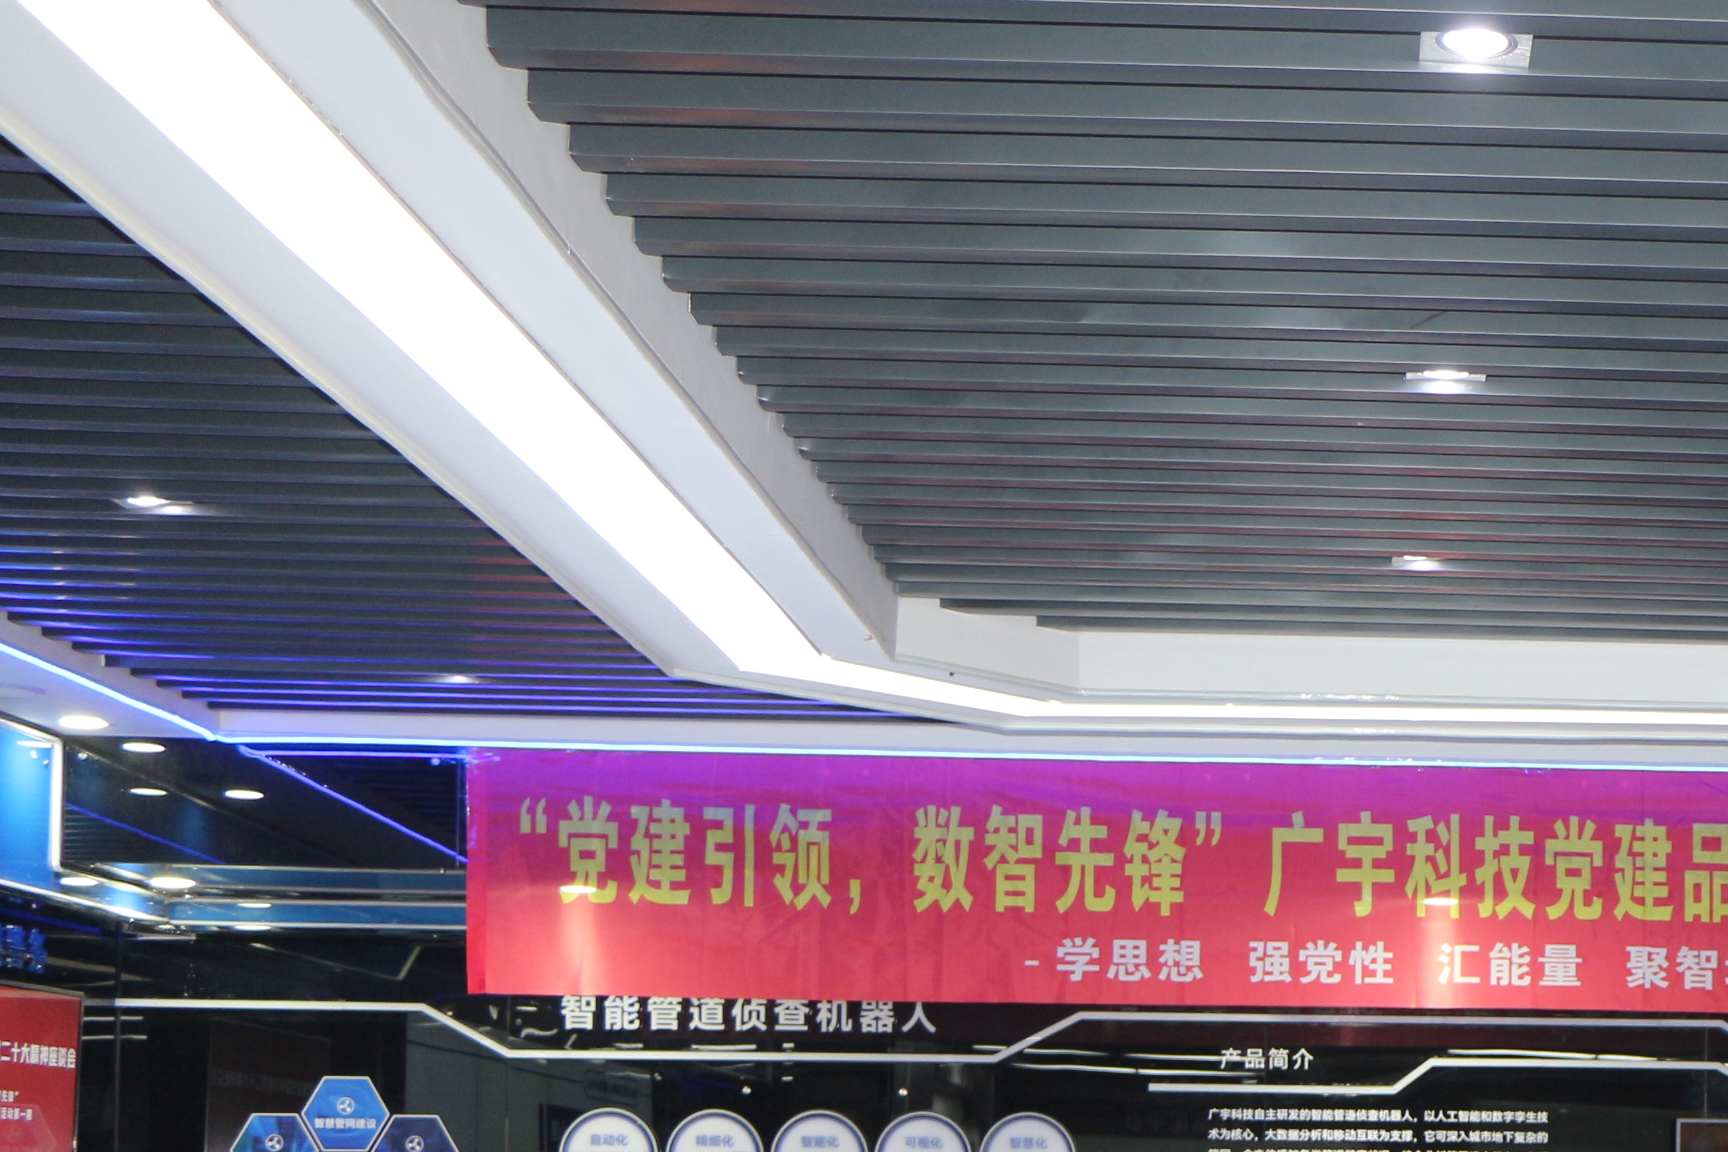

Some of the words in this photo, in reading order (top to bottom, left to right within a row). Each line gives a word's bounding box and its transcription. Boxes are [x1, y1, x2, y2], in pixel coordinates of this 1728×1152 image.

[1249, 940, 1395, 985] 强党性
[1438, 943, 1583, 988] 汇能量
[561, 995, 937, 1033] 智能管道侦查机器人
[0, 1041, 76, 1068] 二十大精神座谈会
[1220, 1047, 1314, 1071] 产品简介
[590, 1134, 628, 1146] 自动化
[696, 1135, 734, 1146] 精细化
[801, 1136, 839, 1148] 智能化
[905, 1136, 943, 1149] 可视化
